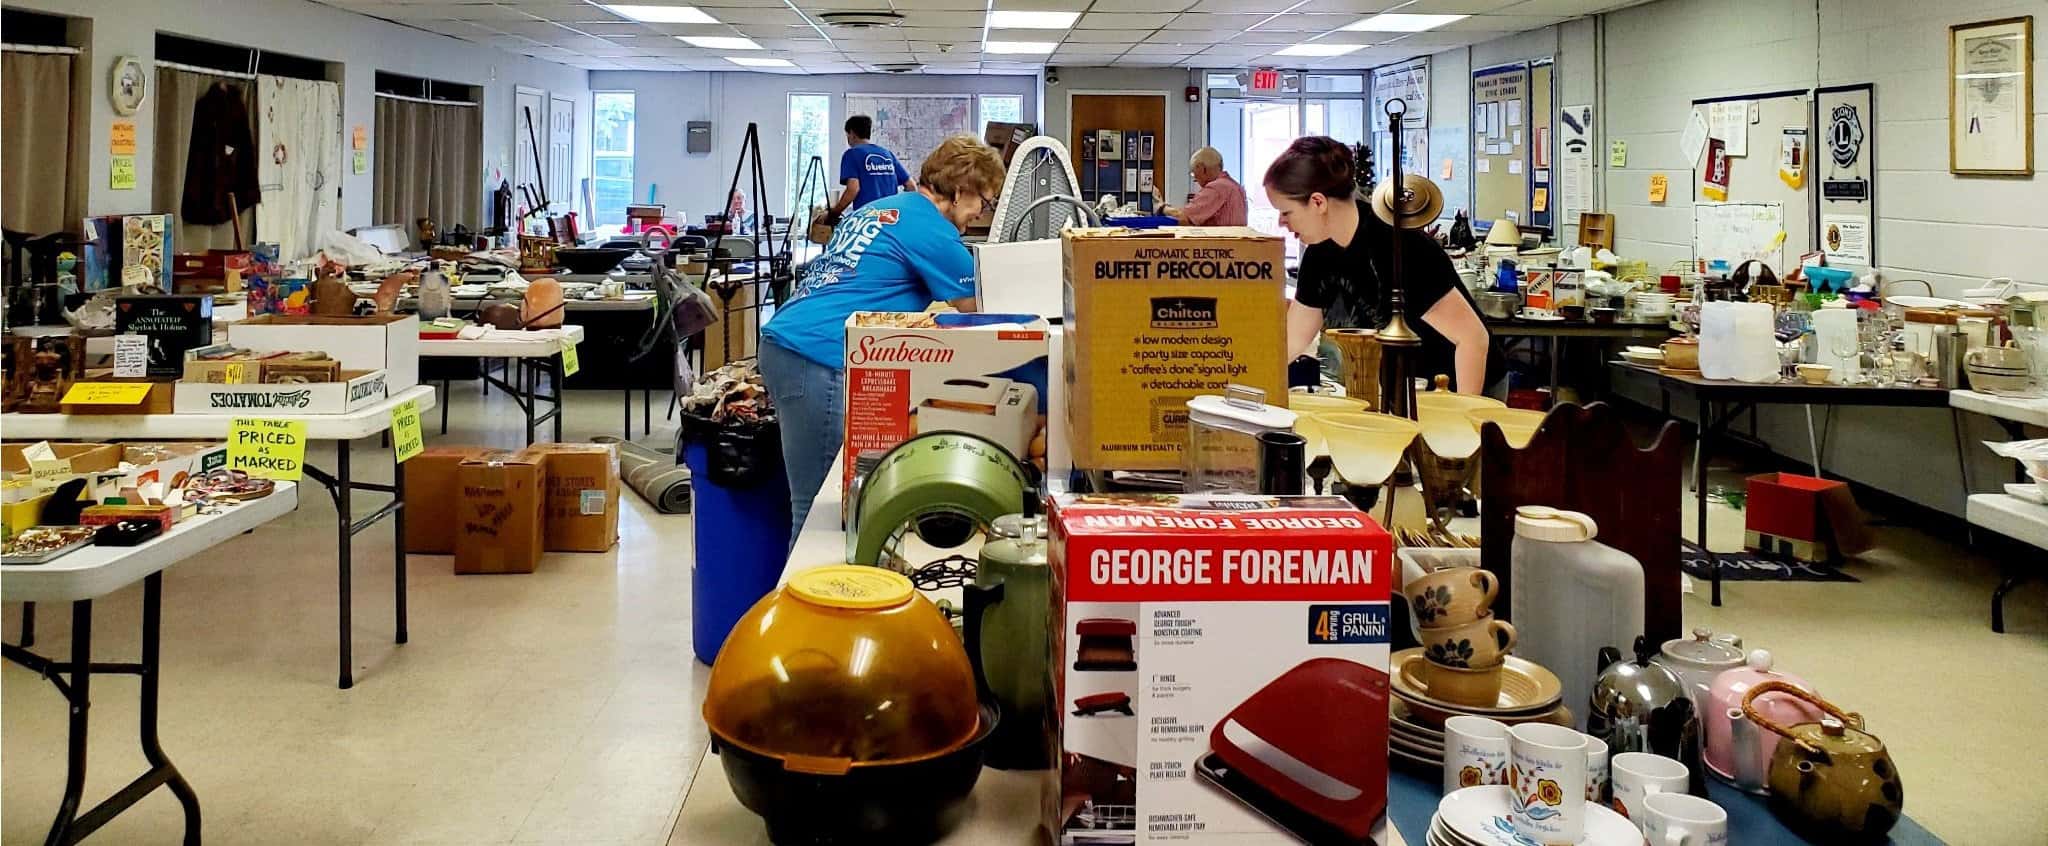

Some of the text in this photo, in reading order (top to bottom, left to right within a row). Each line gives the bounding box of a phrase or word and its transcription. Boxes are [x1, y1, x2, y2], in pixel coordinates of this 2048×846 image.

[1254, 71, 1278, 89] EXIT
[1477, 75, 1523, 88] FRANKLIN TOWNSHIP
[1485, 89, 1498, 97] CIVIC
[1833, 107, 1852, 120] LIONS
[1838, 122, 1849, 146] L
[1134, 248, 1235, 260] AUTOMATIC ELECTRIC
[1095, 261, 1273, 280] BUFFET PERCOLATOR
[1528, 272, 1551, 294] PREMIUM
[152, 308, 166, 316] The
[1157, 307, 1212, 320] Chilton
[128, 323, 188, 331] Sherlock Holmes
[1142, 334, 1233, 347] low modern design
[850, 335, 954, 365] Sunbeam
[1142, 350, 1234, 361] party size capacity
[1199, 364, 1226, 376] signal
[1227, 364, 1248, 376] light
[1150, 379, 1229, 390] detachable cord
[210, 392, 273, 407] TOMATOES
[236, 418, 292, 429] THIS TABLE
[397, 414, 416, 431] PRICED
[238, 430, 296, 445] PRICED
[398, 437, 419, 457] MARKED
[234, 456, 297, 471] MARKED
[1083, 514, 1364, 530] GEORGE FOREMAN
[1090, 549, 1373, 585] GEORGE FOREMAN
[1154, 610, 1181, 618] ADVANCED
[1154, 619, 1174, 627] GEORGE
[1315, 611, 1329, 640] 4
[1329, 610, 1341, 640] serving
[1342, 613, 1381, 624] GRILL
[1154, 628, 1203, 637] NONSTICK COATING
[1342, 625, 1385, 637] PANINI
[1151, 716, 1177, 725] EXCLUSIVE
[1160, 725, 1187, 734] REMOVING
[1150, 761, 1182, 770] COOL TOUCH
[1150, 770, 1186, 779] PLATE RELEASE
[1148, 813, 1196, 823] DISHWASHER SAFE
[1148, 823, 1206, 832] REMOVABLE DRIP TRAY
